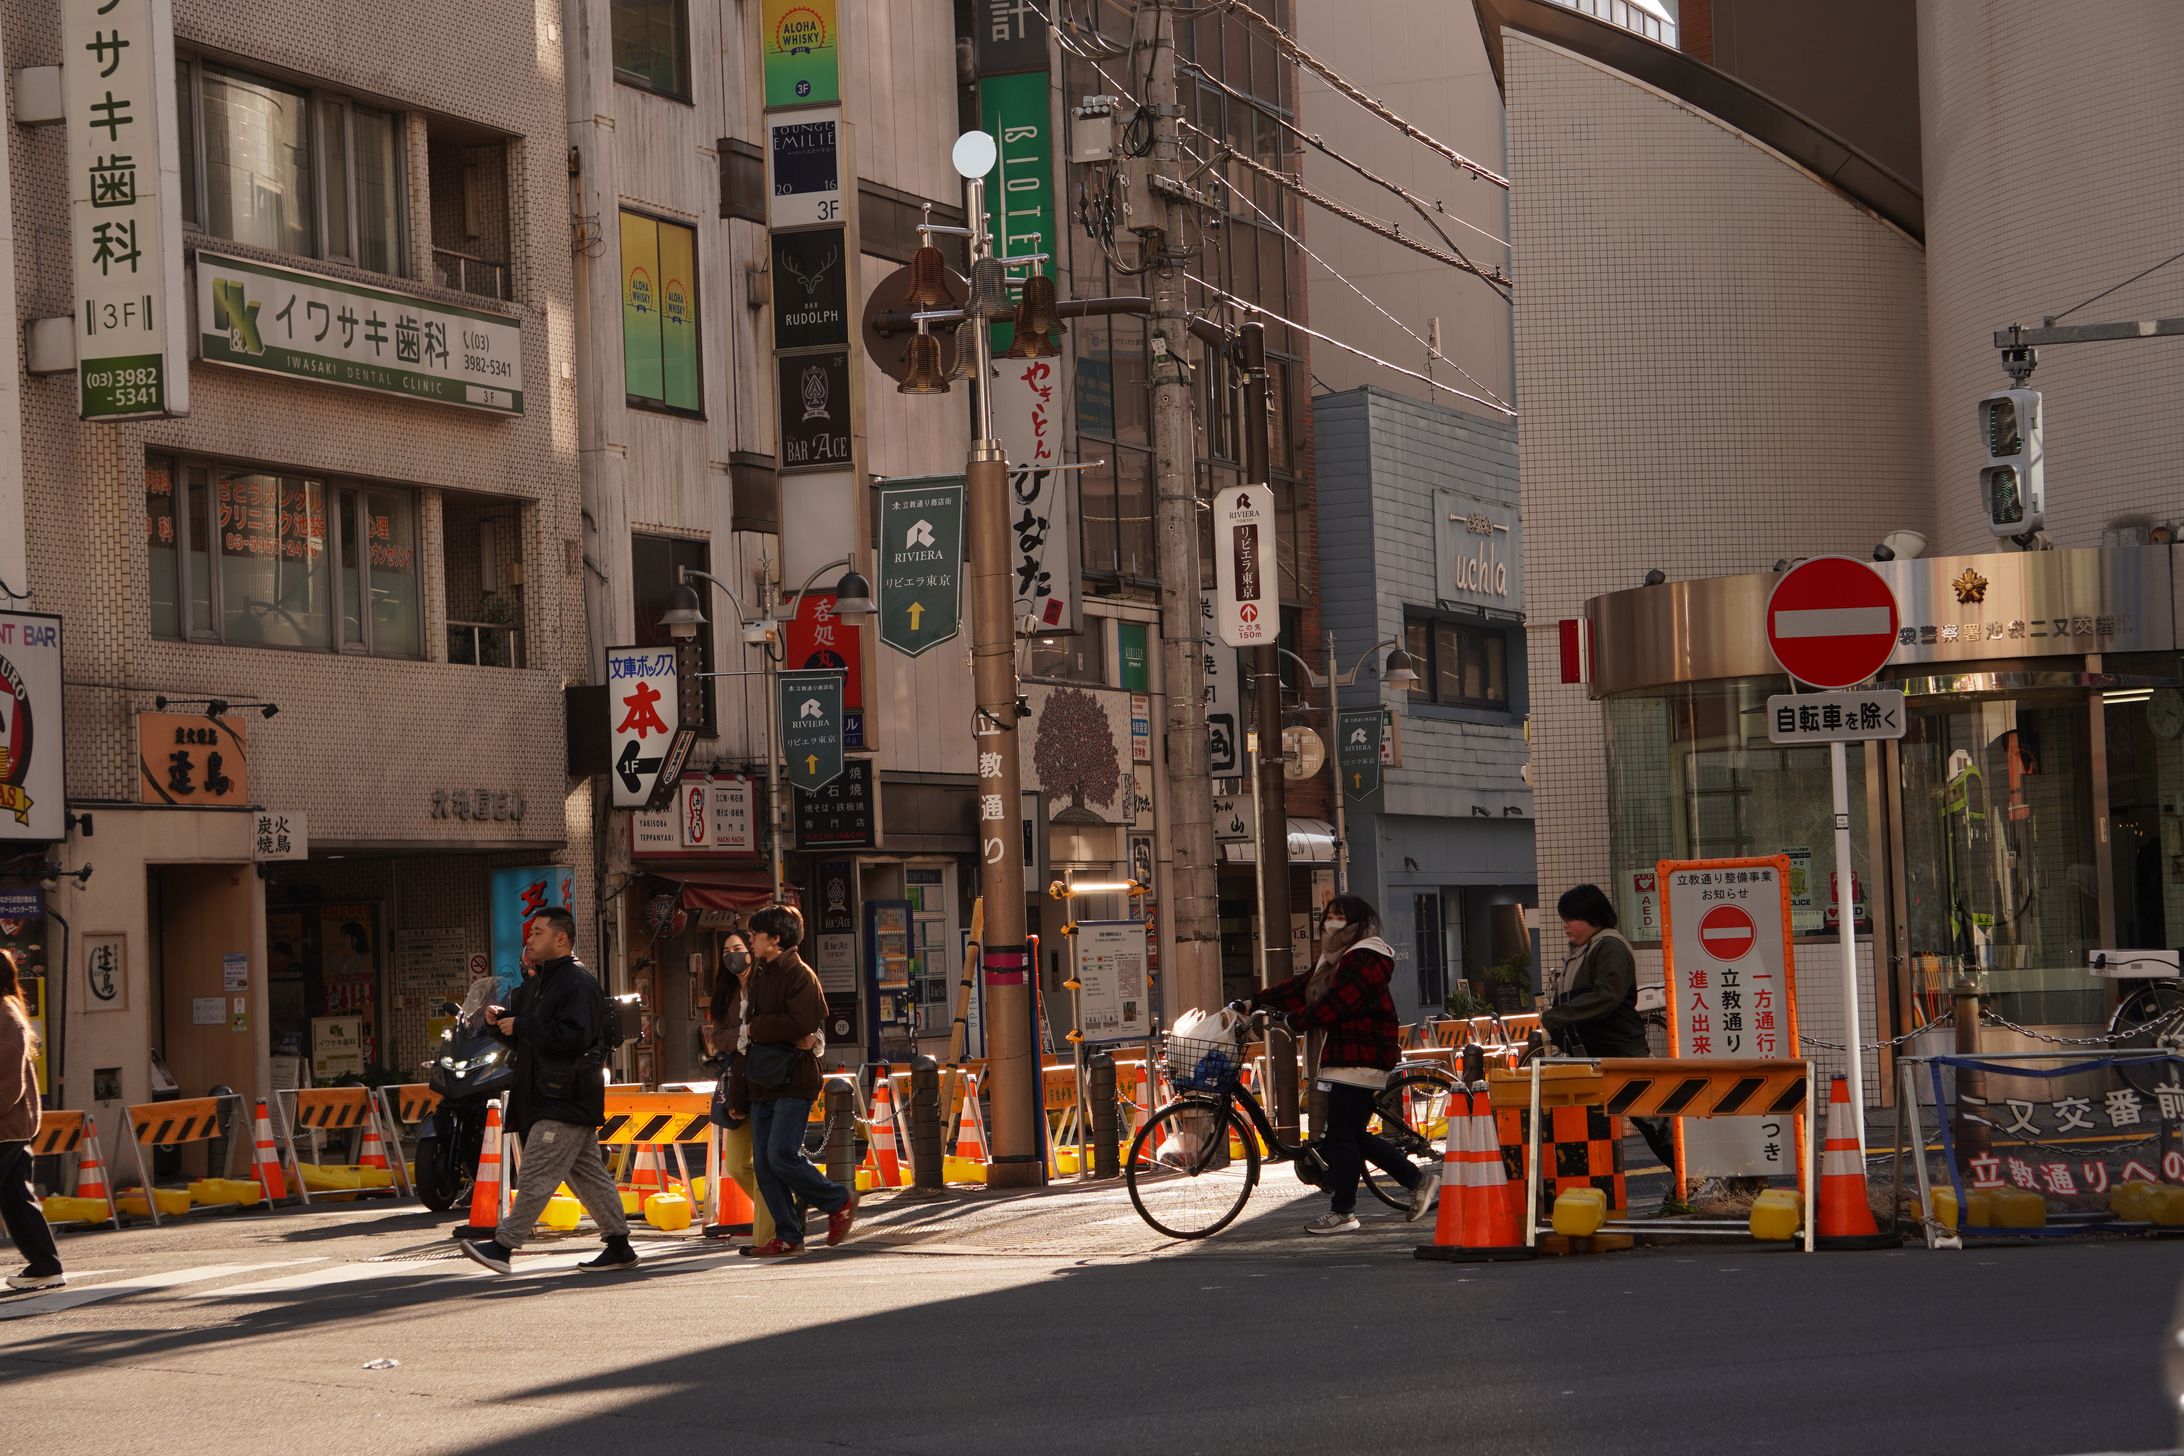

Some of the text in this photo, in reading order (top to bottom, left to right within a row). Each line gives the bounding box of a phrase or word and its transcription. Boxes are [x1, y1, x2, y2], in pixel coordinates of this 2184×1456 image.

[783, 20, 817, 34] ALOHA
[782, 32, 820, 46] WHISKY
[797, 84, 809, 94] 3F
[773, 131, 835, 151] EMILIE
[776, 179, 837, 196] 20 16
[817, 200, 840, 221] 3F
[1004, 125, 1042, 301] BIOTE
[632, 280, 650, 292] ALOHA
[632, 291, 651, 304] WHISKY
[668, 291, 684, 303] ALOHA
[668, 303, 686, 315] WHISKY
[804, 302, 818, 310] BAR
[102, 303, 137, 330] 3F
[785, 310, 839, 326] RUDOLPH
[276, 294, 450, 370] イワサキ歯科
[464, 353, 512, 378] 3982-5341
[833, 355, 845, 367] 2F
[86, 367, 158, 388] (03) 3982
[287, 355, 443, 394] IWASAKI DENTAL CLINIC
[106, 386, 158, 406] -5341
[483, 390, 496, 404] 3F
[787, 432, 848, 462] BAR ACE
[1229, 510, 1260, 520] RIVIERA
[894, 550, 944, 563] RIVIERA
[1240, 526, 1254, 599] リビエラ東京
[886, 574, 951, 591] リビエラ東京
[24, 625, 56, 648] BAR
[1238, 624, 1261, 632] この先
[1239, 631, 1262, 639] 150m
[610, 654, 676, 679] 文庫ボックス
[616, 681, 669, 739] 本
[1777, 703, 1897, 733] 自転車を除く
[792, 719, 830, 729] RIVIERA
[787, 735, 836, 747] リビエラ東京
[624, 760, 639, 773] 1F
[978, 711, 1005, 864] 立教通り
[639, 820, 667, 828] YAKISOBA
[640, 833, 674, 842] TEPPANYAKI
[806, 831, 832, 841] HACHI
[1677, 870, 1772, 886] 立教通り整備事業
[1702, 888, 1749, 901] お知らせ
[1642, 896, 1653, 926] AED
[1688, 969, 1713, 1055] 進入出来
[1721, 969, 1743, 1052] 立教通り
[1752, 974, 1776, 1052] 一方通行
[1960, 1081, 2184, 1134] 二又交番前
[1761, 1121, 1781, 1161] つき
[1968, 1151, 2184, 1197] 立教通りへの
